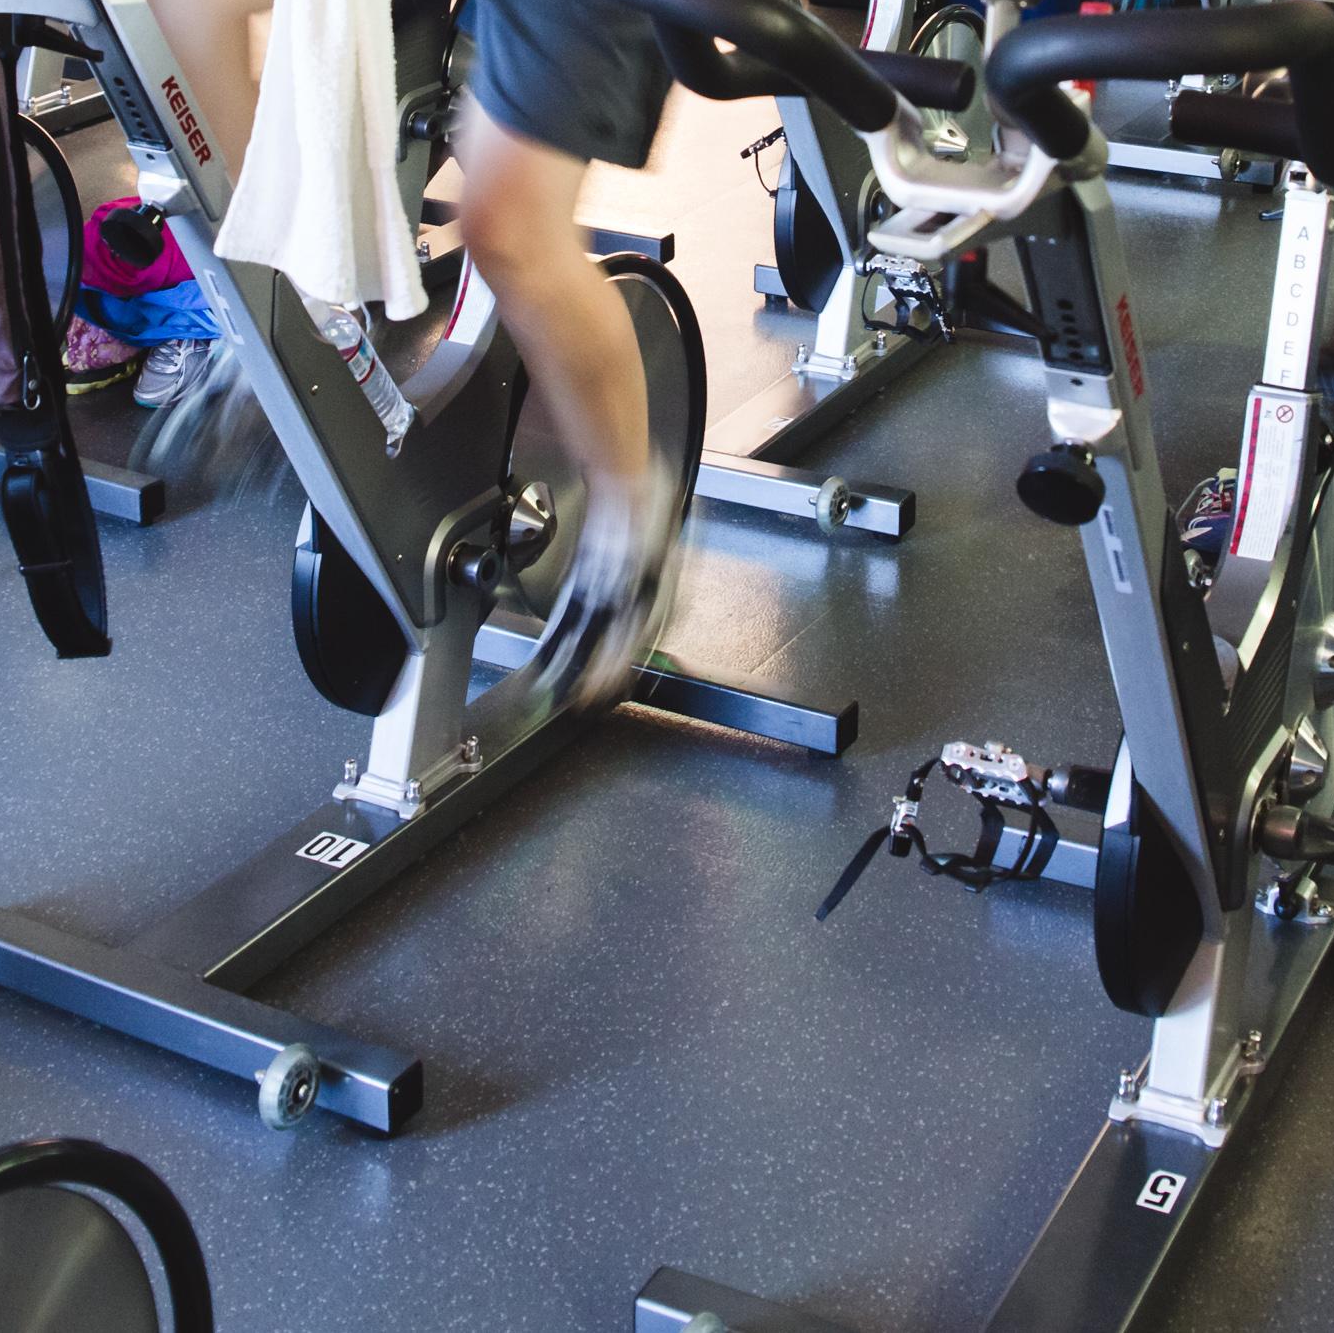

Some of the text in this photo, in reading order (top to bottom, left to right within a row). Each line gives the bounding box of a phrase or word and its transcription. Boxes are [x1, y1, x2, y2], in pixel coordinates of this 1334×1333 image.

[161, 75, 211, 167] KEISER
[1297, 226, 1309, 241] A
[1294, 254, 1306, 269] B
[1290, 283, 1303, 298] C
[1286, 312, 1299, 327] D
[304, 836, 357, 862] 10
[1144, 1175, 1177, 1208] 5
